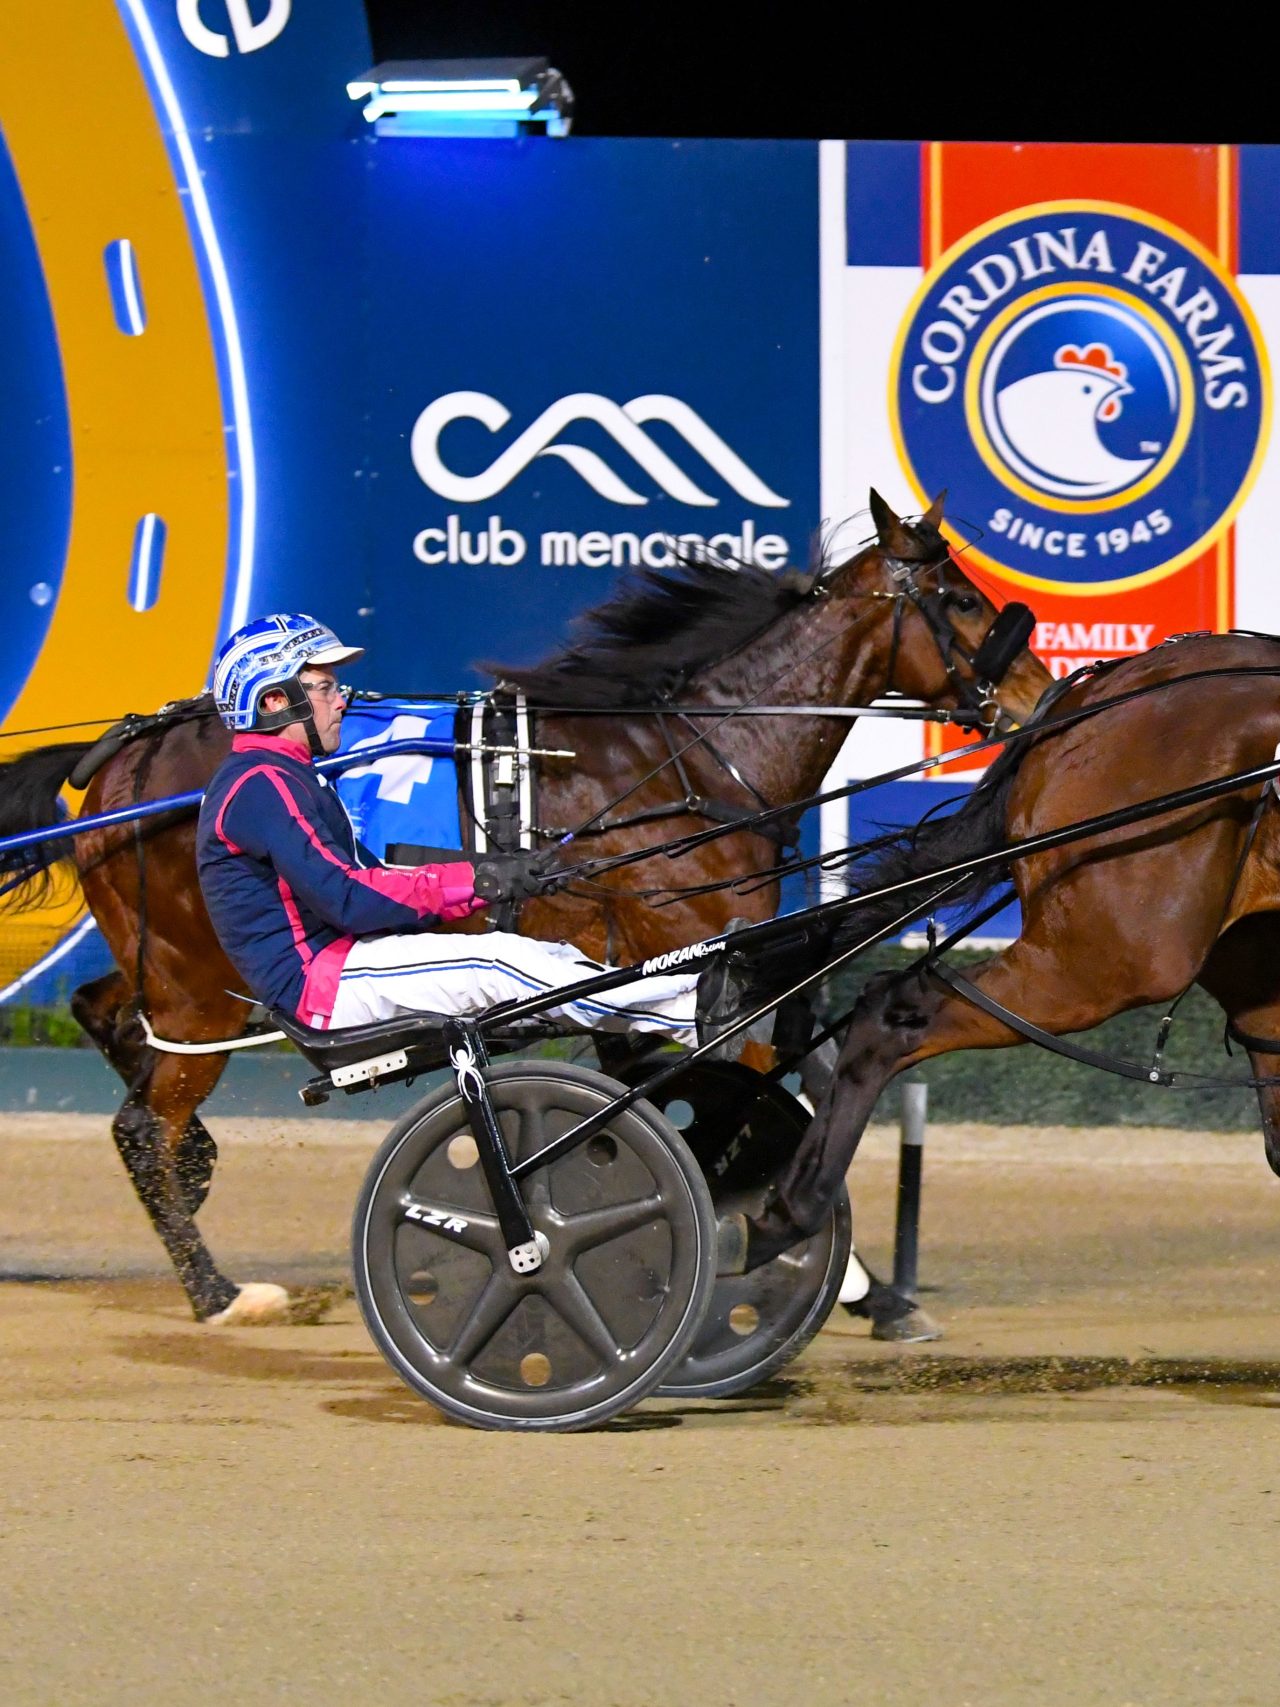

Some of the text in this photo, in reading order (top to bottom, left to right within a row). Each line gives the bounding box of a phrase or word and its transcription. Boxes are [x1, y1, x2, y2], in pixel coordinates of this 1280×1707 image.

[912, 227, 1248, 410] CORDINA FARMS
[413, 515, 789, 571] club menangle
[988, 508, 1172, 558] SINCE 1945
[1036, 622, 1155, 651] FAMILY
[339, 714, 434, 805] 4
[642, 942, 703, 976] MORAN
[405, 1203, 469, 1233] LZR
